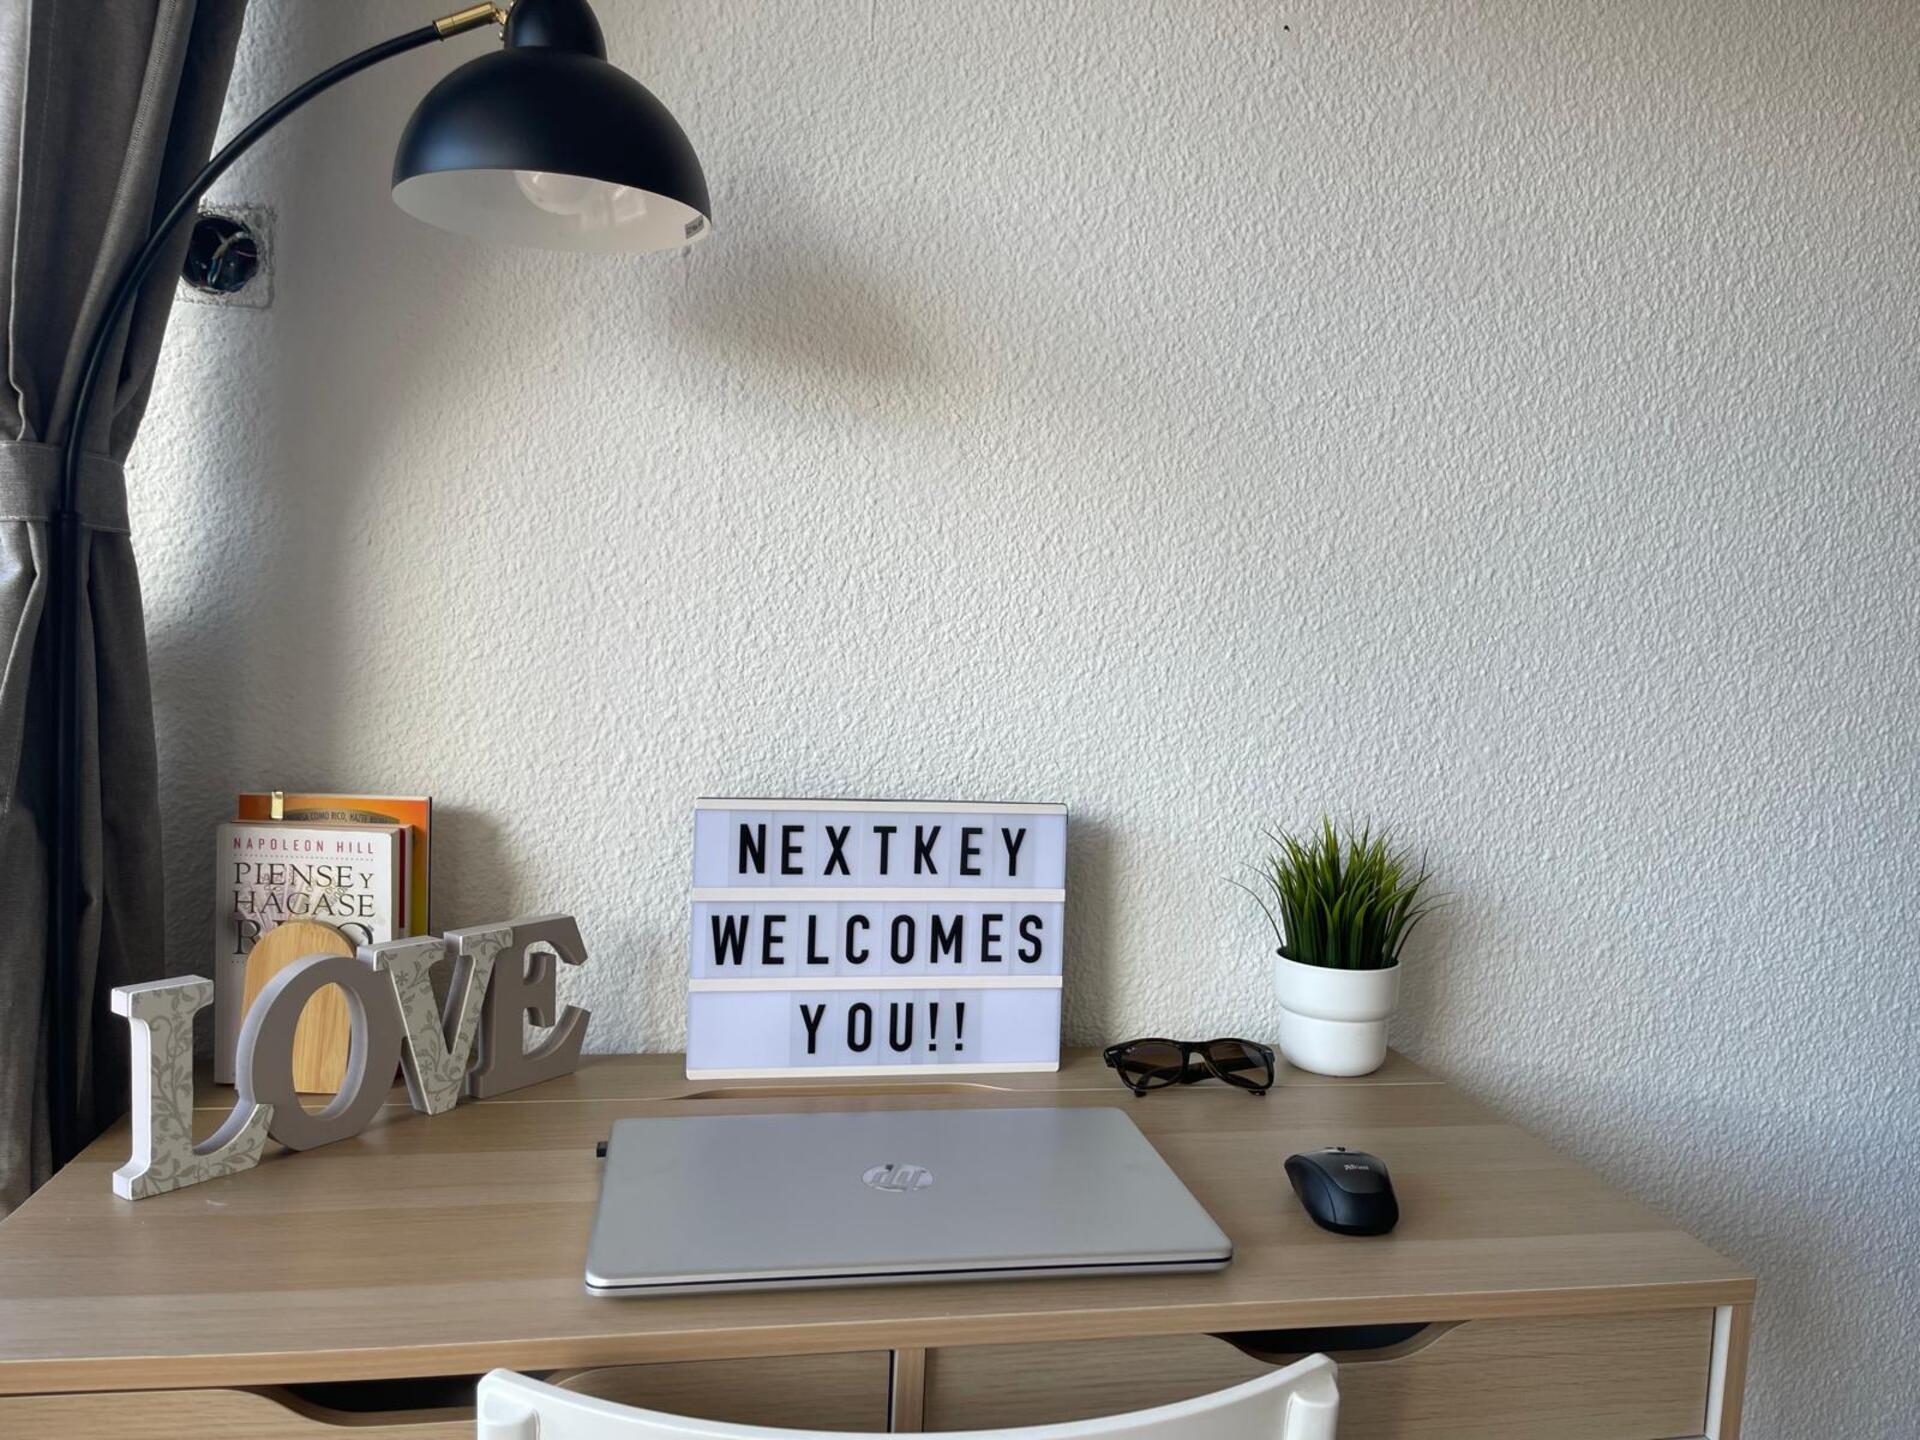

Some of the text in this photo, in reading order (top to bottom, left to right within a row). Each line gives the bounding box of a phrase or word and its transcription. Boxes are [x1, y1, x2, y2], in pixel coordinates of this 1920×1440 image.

[233, 836, 374, 855] NAPOLEON HILL
[738, 823, 1027, 877] NEXTKEY
[233, 861, 375, 889] PIENSE Y
[710, 914, 1044, 965] WELCOMES
[799, 1002, 966, 1054] YOU!!
[111, 913, 592, 1201] LOVE
